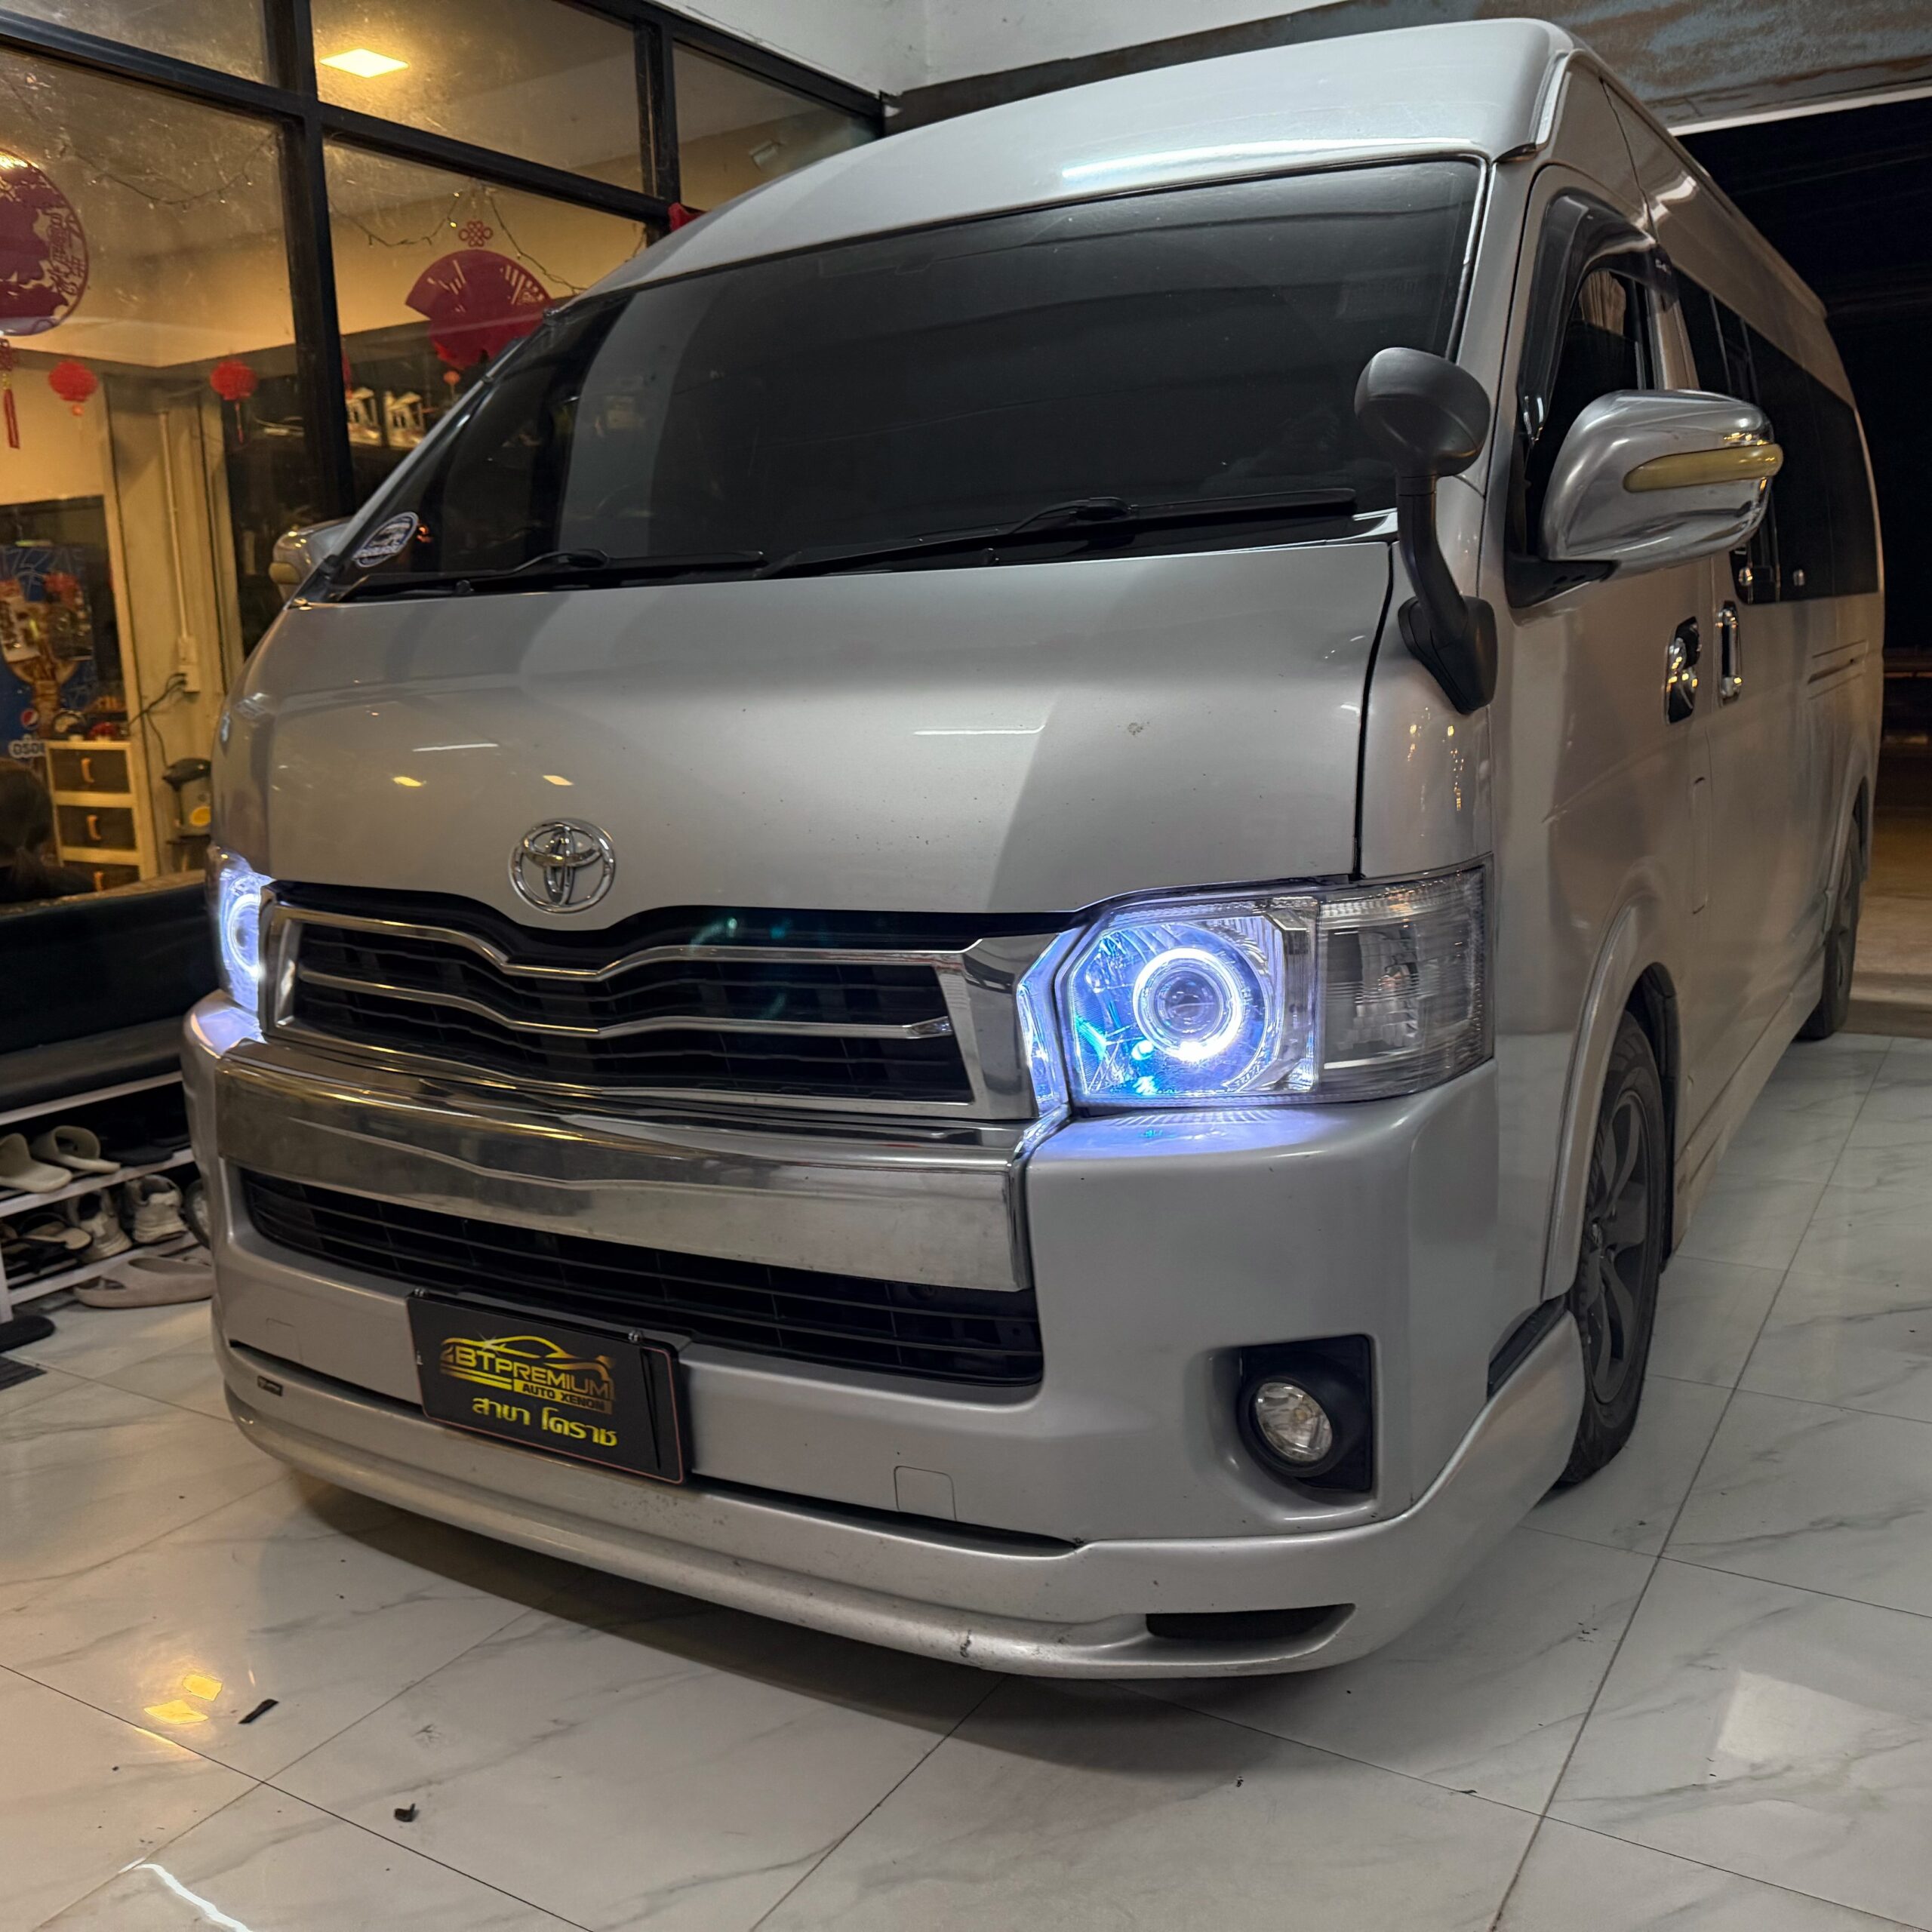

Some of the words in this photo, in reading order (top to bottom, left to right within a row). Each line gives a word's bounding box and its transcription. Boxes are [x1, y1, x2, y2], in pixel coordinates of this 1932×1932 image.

[522, 1383, 555, 1399] AUTO
[561, 1392, 605, 1411] XENON
[472, 1397, 531, 1426] สาขา
[542, 1407, 618, 1447] โคราช
